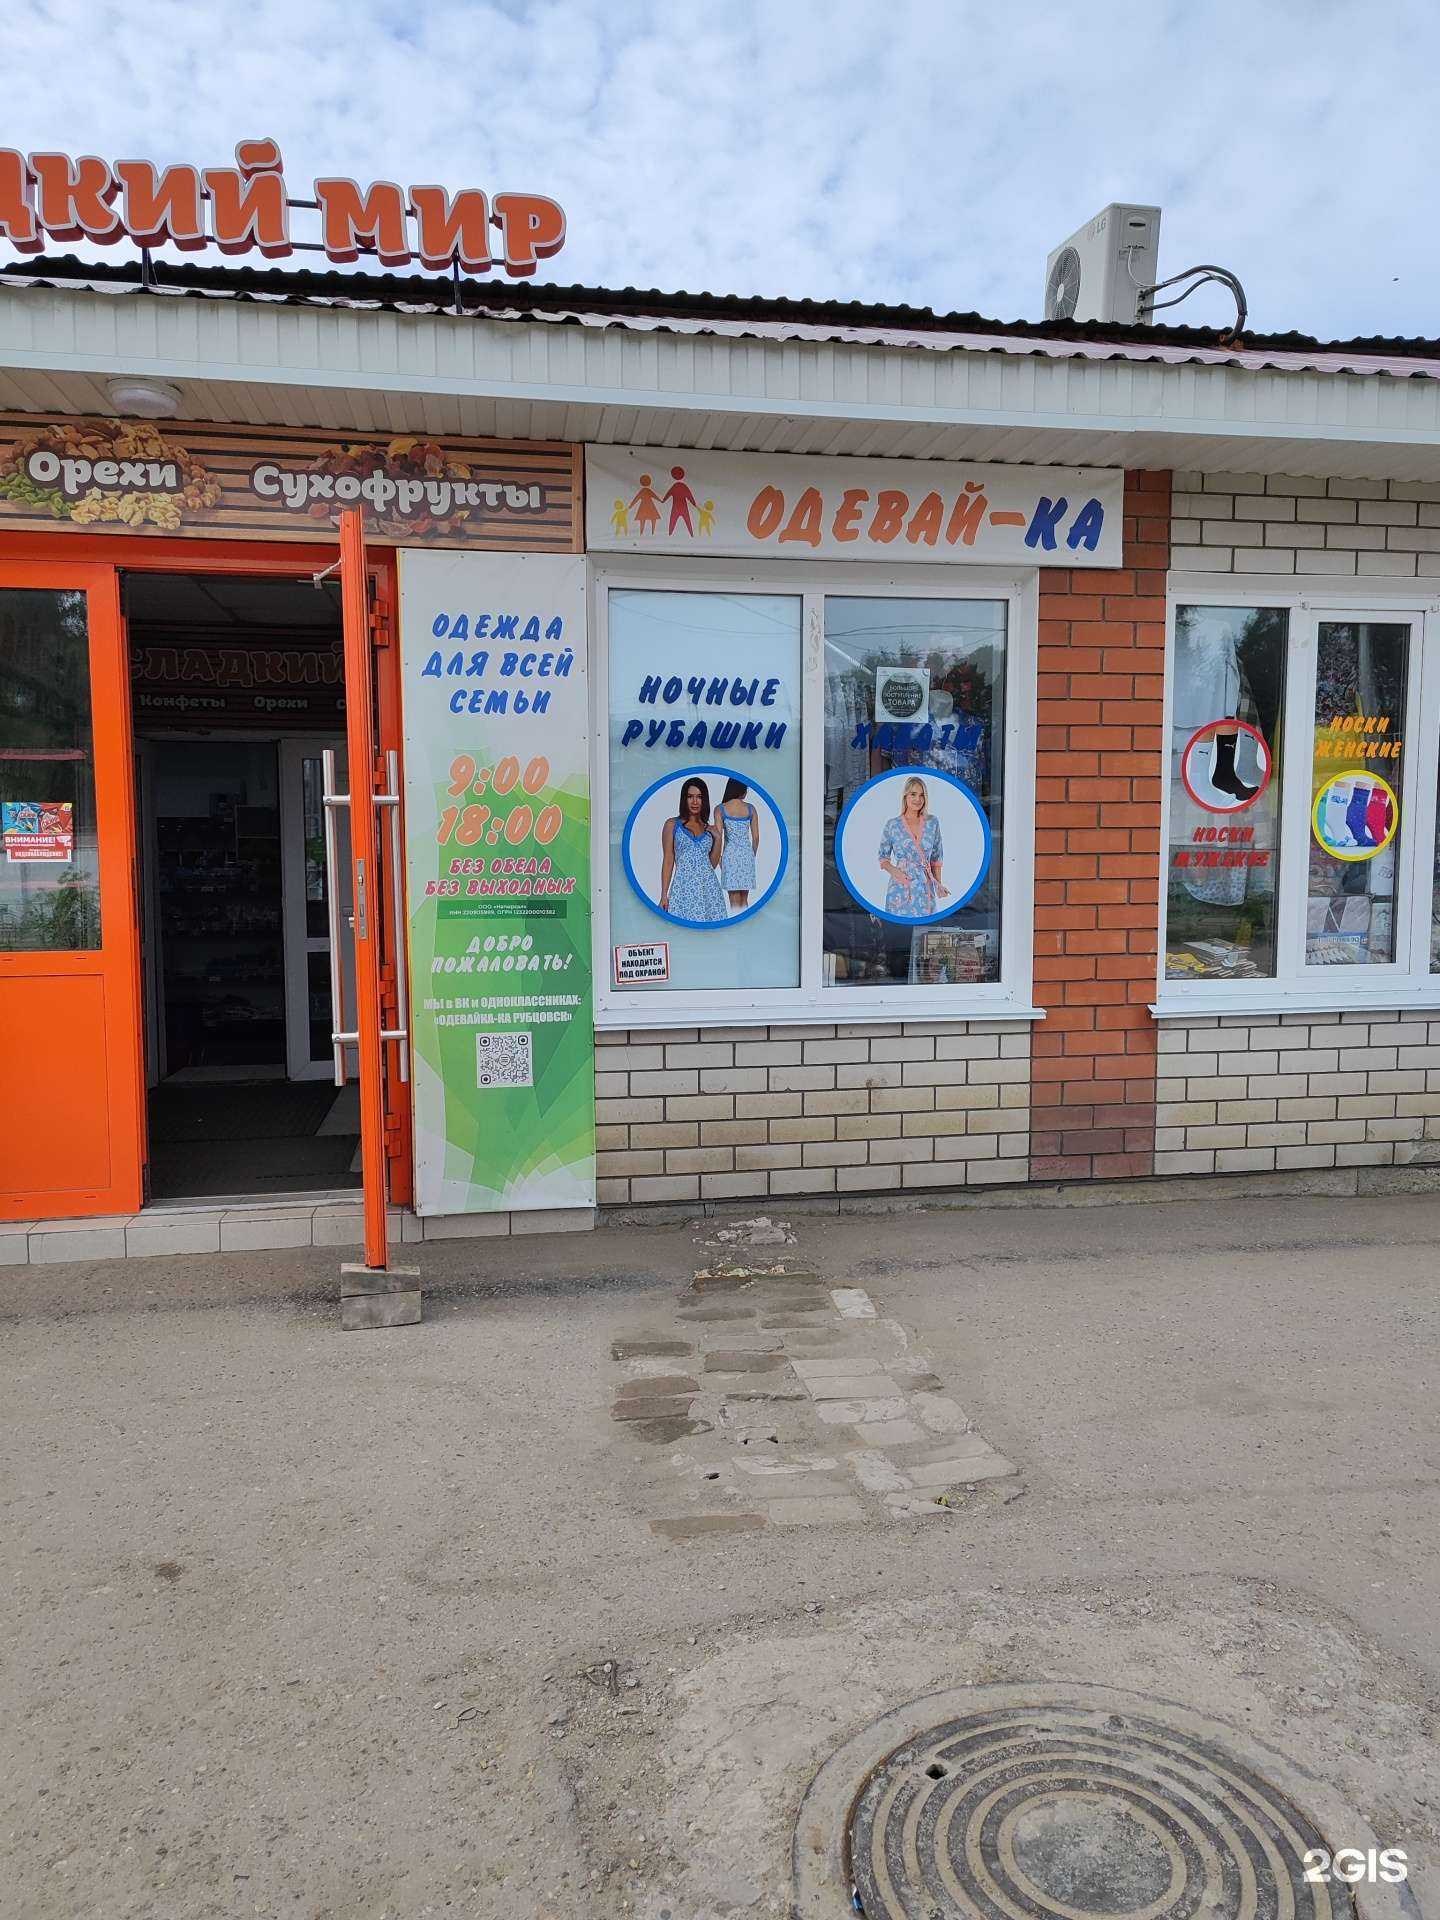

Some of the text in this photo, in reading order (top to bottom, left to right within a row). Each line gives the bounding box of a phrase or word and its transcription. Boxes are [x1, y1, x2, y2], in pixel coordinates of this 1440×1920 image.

[314, 177, 566, 277] МИР
[29, 452, 177, 493] Орехи
[253, 466, 541, 516] Сухофрукты
[746, 481, 1105, 552] ОДЕВАЙ-КА
[431, 613, 564, 642] ОДЕЖДА
[421, 647, 574, 678] ДЛЯ ВСЕЙ
[450, 689, 552, 714] СЕМЬИ
[638, 675, 781, 708] НОЧНЫЕ
[254, 696, 308, 711] Орехи
[621, 719, 788, 750] РУБАШКИ
[1329, 716, 1391, 734] НОСКИ
[1315, 740, 1402, 759] ЖЕНСКИЕ
[448, 754, 551, 797] 9:00
[435, 803, 563, 846] 18:00
[1193, 826, 1254, 843] НОСКИ
[450, 857, 552, 875] БЕЗ ОБЕДА
[425, 877, 576, 896] БЕЗ ВЫХОДНЫХ
[466, 935, 533, 953] ДОБРО
[628, 948, 654, 957] ОБЪЕКТ
[431, 953, 573, 973] ПОЖАЛОВАТЬ!
[619, 967, 666, 978] ПОД ОХРАНОЙ
[621, 958, 662, 967] НАХОДИТСЯ
[423, 998, 444, 1010] МЫ
